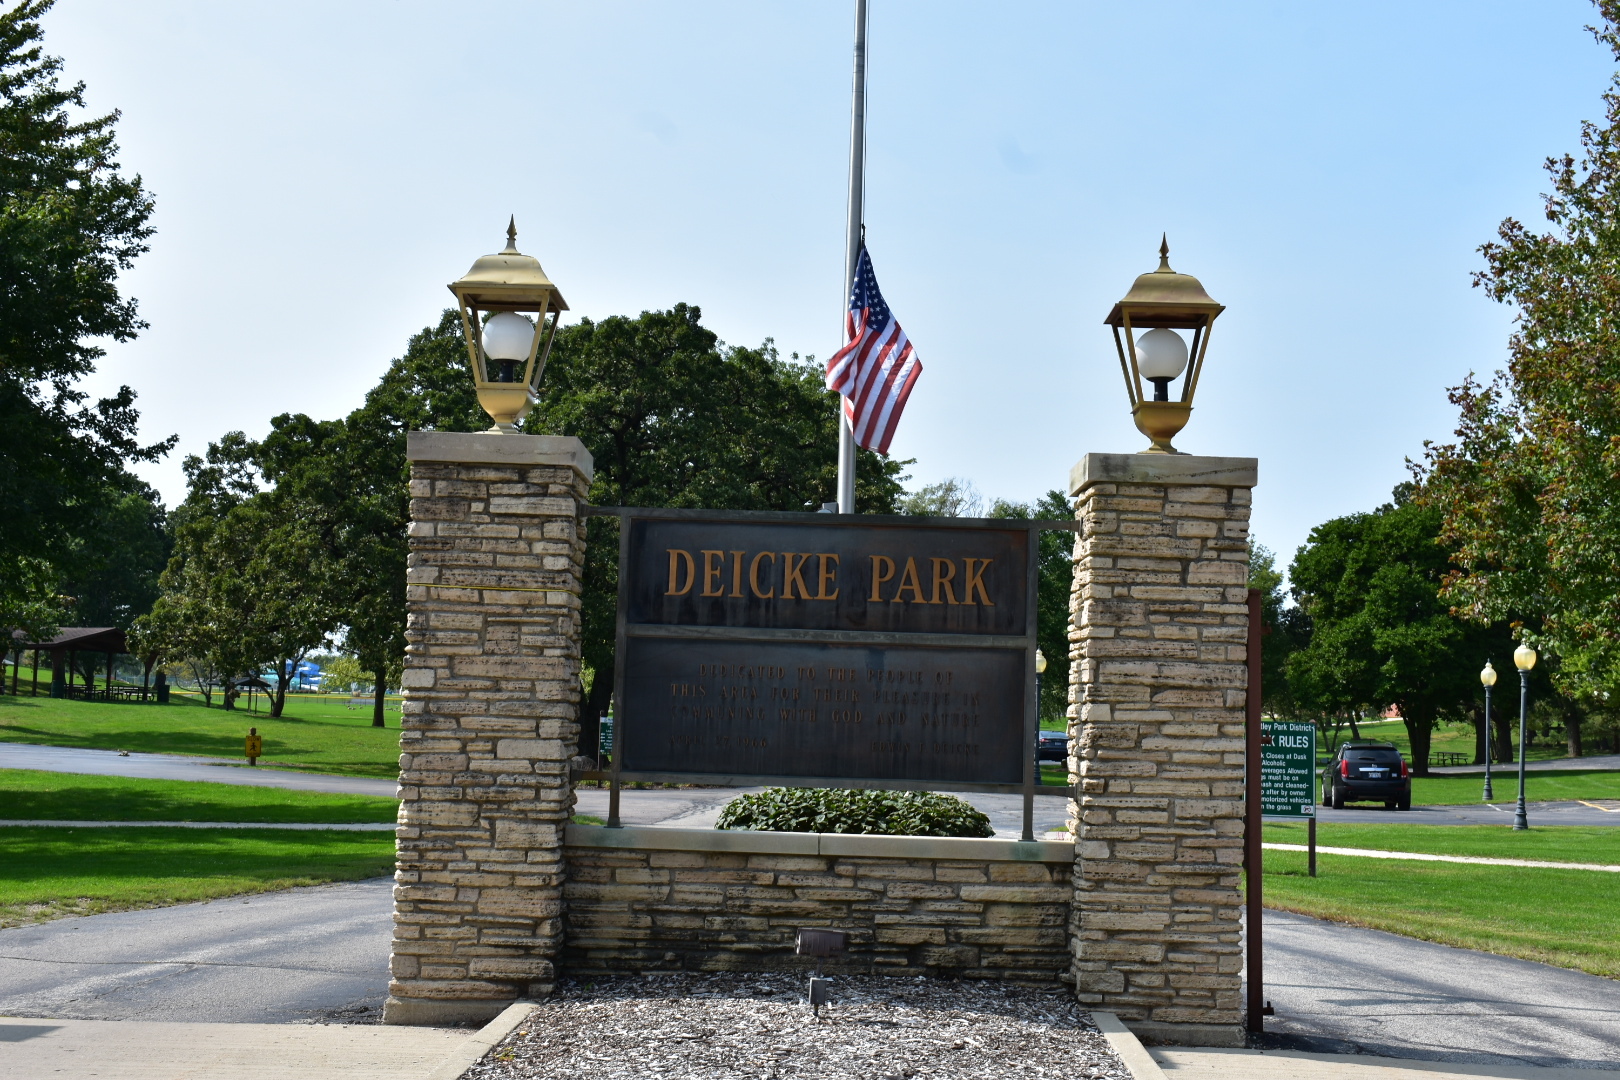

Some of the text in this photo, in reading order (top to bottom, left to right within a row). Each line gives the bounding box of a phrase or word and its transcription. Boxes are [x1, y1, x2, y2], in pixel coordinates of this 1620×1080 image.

[664, 549, 995, 606] DEICKE PARK
[699, 663, 953, 685] DEDICATED TO THE PEOPLE OF
[671, 683, 980, 706] THIS AREA FOR THEIR PLEASURE IN
[671, 705, 980, 727] COMMUNING WITH GOD AND NATURE
[1273, 722, 1288, 731] Park
[1289, 723, 1312, 731] District
[669, 734, 705, 745] APRIL
[737, 736, 767, 748] 1966
[871, 741, 911, 752] EDWIN
[933, 743, 980, 755] DEICKE
[1278, 735, 1309, 748] RULES
